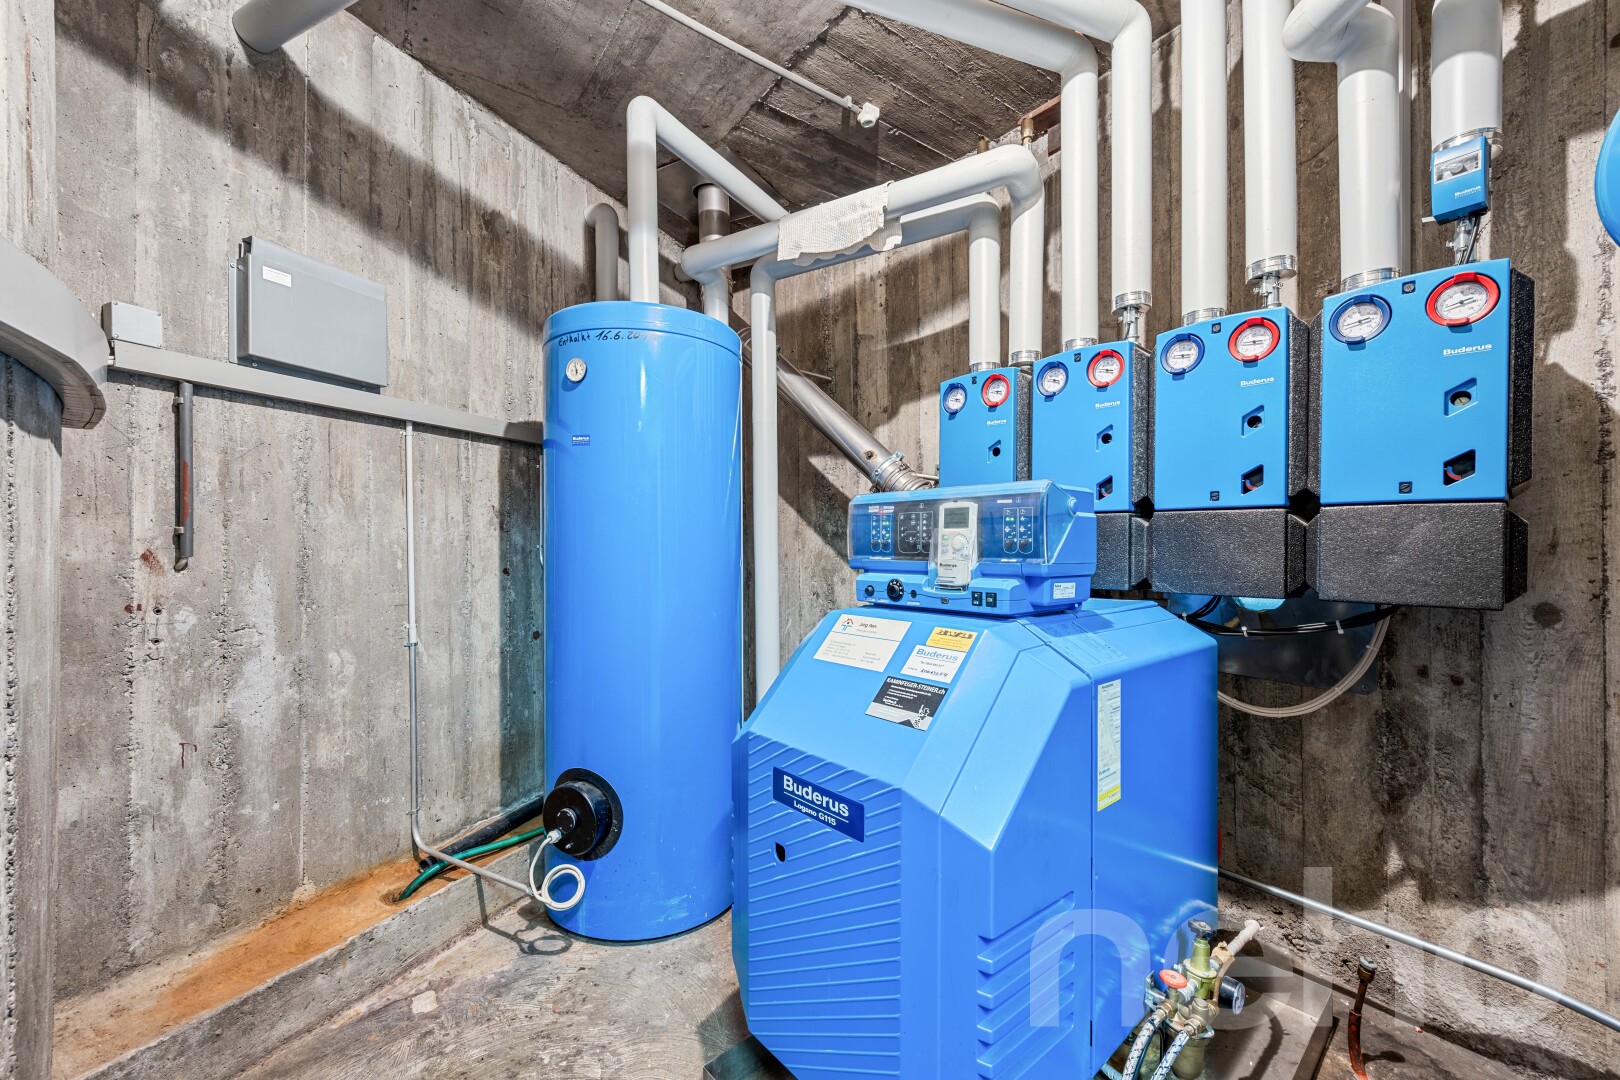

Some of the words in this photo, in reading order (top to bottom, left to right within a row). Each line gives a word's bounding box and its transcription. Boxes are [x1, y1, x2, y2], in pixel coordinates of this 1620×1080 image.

[1442, 343, 1493, 356] Buderus
[1240, 376, 1275, 386] Buderus
[1095, 400, 1120, 408] Buderus
[916, 647, 959, 662] Buderus
[886, 677, 946, 695] KAMINFEGER-STEINER.ch
[783, 774, 850, 817] Buderus
[793, 799, 817, 817] Logano
[818, 812, 837, 826] G115
